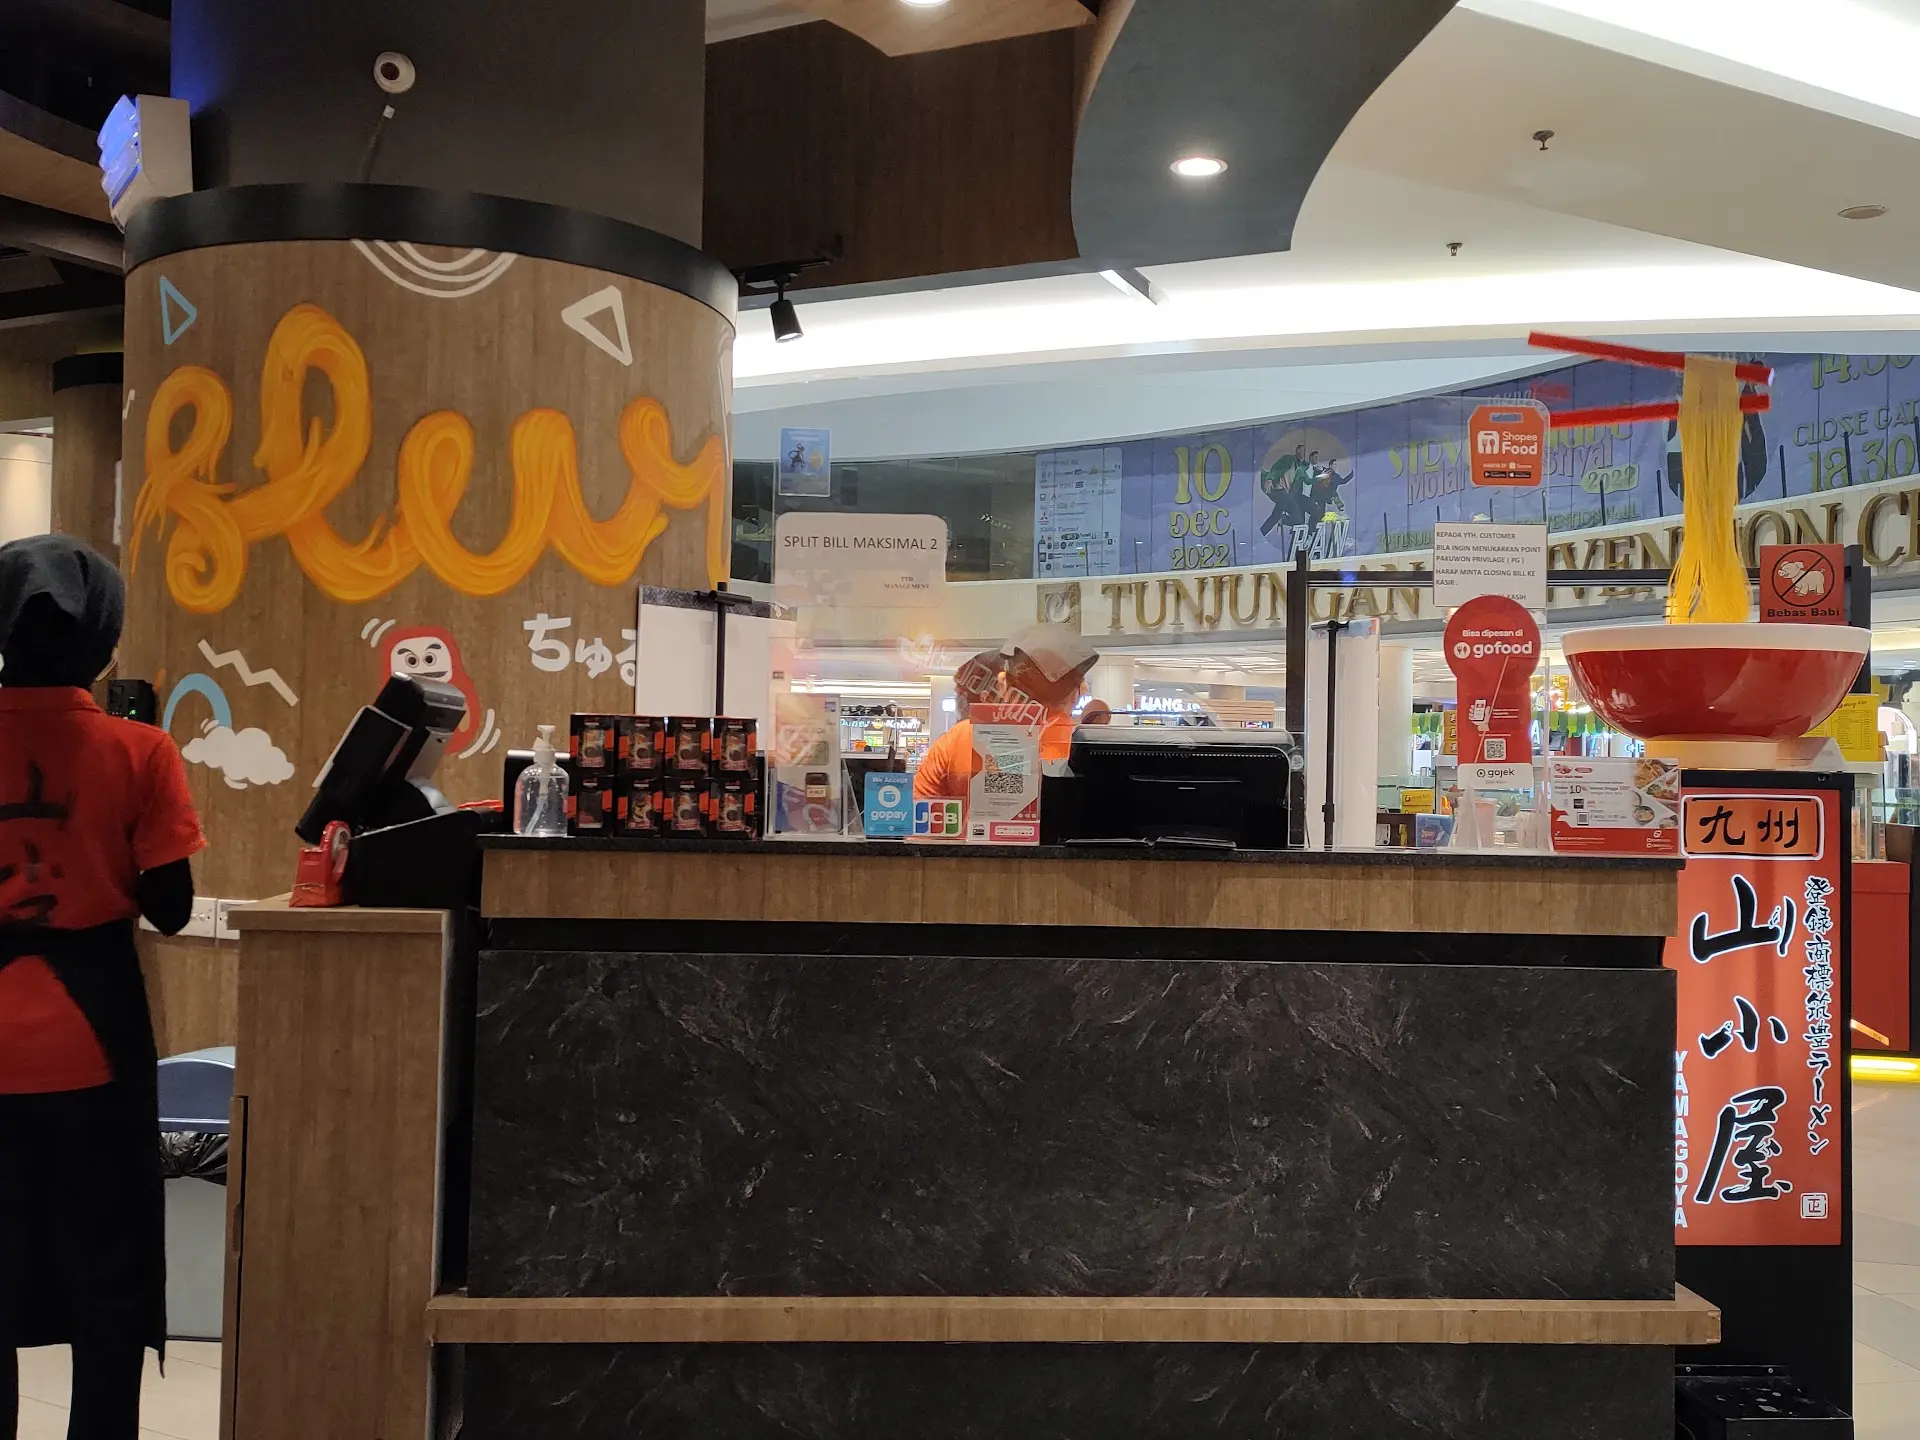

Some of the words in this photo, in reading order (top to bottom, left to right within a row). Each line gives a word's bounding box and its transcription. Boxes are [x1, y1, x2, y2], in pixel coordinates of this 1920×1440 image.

[1793, 410, 1869, 447] CLOSE
[1874, 398, 1920, 430] GAT
[1502, 430, 1538, 443] Shopee
[1502, 441, 1538, 455] Food
[1808, 433, 1916, 492] 1830
[1173, 443, 1233, 505] 10
[1169, 507, 1231, 539] DEC
[784, 535, 819, 548] SPLIT
[823, 536, 849, 548] BILL
[853, 537, 926, 549] MAKSIMAL
[930, 538, 938, 550] 2
[1289, 519, 1351, 562] RAN
[1472, 545, 1519, 553] MENUKARKAN
[1170, 543, 1231, 570] 2022
[1767, 608, 1806, 617] Bebas
[1811, 608, 1839, 617] Babi
[1462, 629, 1480, 637] Bisa
[1481, 629, 1514, 638] dipesan
[1515, 628, 1524, 637] di
[1473, 640, 1533, 659] gofood
[884, 776, 908, 784] Accept
[1488, 768, 1515, 779] gojek
[870, 811, 908, 821] gopay
[1699, 805, 1799, 849] 九州
[1674, 1050, 1689, 1229] YAMAGOYA
